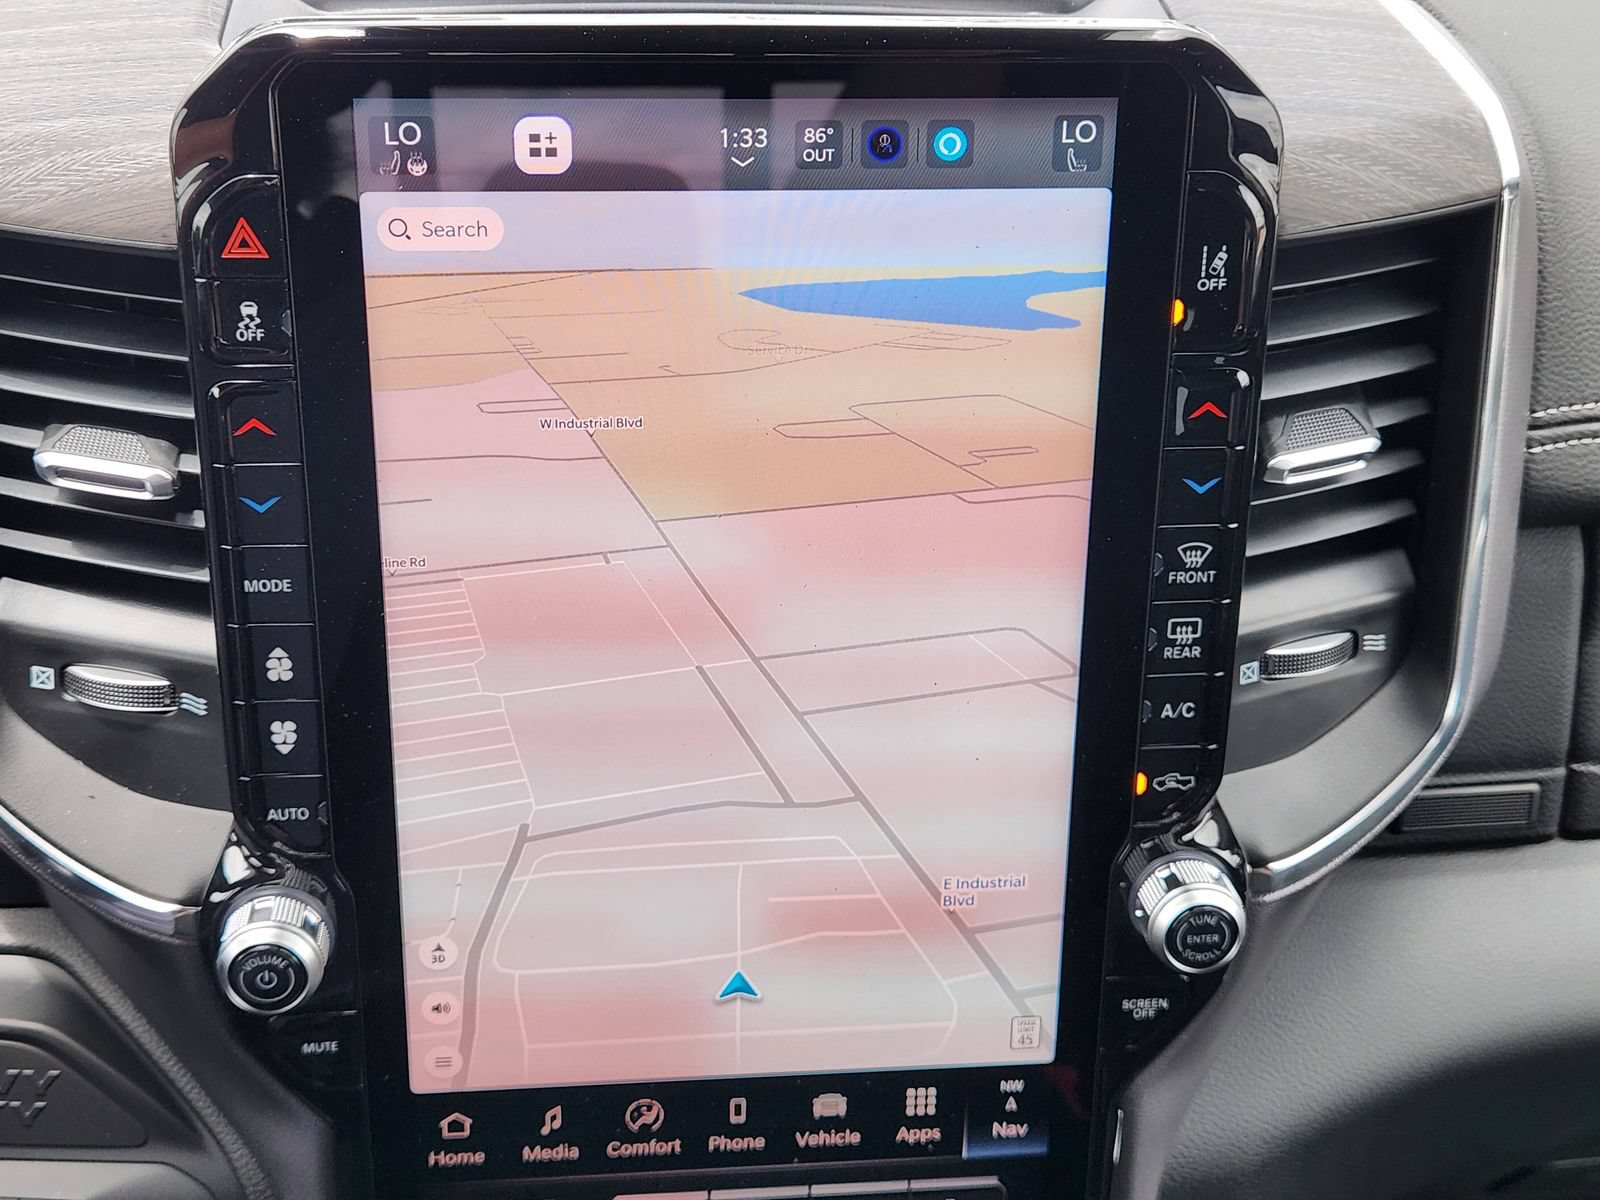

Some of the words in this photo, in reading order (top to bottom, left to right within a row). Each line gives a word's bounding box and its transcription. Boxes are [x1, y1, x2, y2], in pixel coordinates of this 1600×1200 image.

[384, 121, 422, 146] LO
[720, 127, 768, 149] 1:33
[803, 126, 835, 144] 86°
[1061, 119, 1097, 144] LO
[803, 148, 835, 163] OUT
[421, 220, 489, 238] Search
[1197, 278, 1228, 291] OFF
[235, 328, 265, 342] OFF
[540, 418, 552, 429] W
[555, 417, 613, 429] Industrial
[616, 417, 643, 428] Blvd
[381, 557, 407, 568] line
[409, 556, 426, 568] Rd
[1168, 570, 1217, 584] FRONT
[243, 578, 293, 593] MODE
[1163, 646, 1201, 659] REAR
[1160, 701, 1196, 719] A/C
[266, 807, 310, 821] AUTO
[943, 878, 952, 890] E
[956, 875, 1026, 889] Industrial
[943, 894, 975, 907] Blvd
[1189, 914, 1219, 927] TUNE
[1186, 933, 1219, 944] ENTER
[431, 954, 446, 964] 3D
[1181, 948, 1221, 961] SCROLL
[241, 955, 290, 972] VOLUME
[1121, 997, 1169, 1011] SCREEN
[1132, 1007, 1157, 1021] OFF
[1017, 1034, 1033, 1045] 45
[301, 1040, 340, 1055] MUTE
[1000, 1079, 1025, 1093] NW
[896, 1125, 942, 1146] Apps
[992, 1121, 1029, 1139] Nav
[708, 1135, 766, 1153] Phone
[795, 1128, 862, 1149] Vehicle
[522, 1143, 580, 1164] Media
[606, 1138, 683, 1159] Comfort
[427, 1149, 486, 1168] Home
